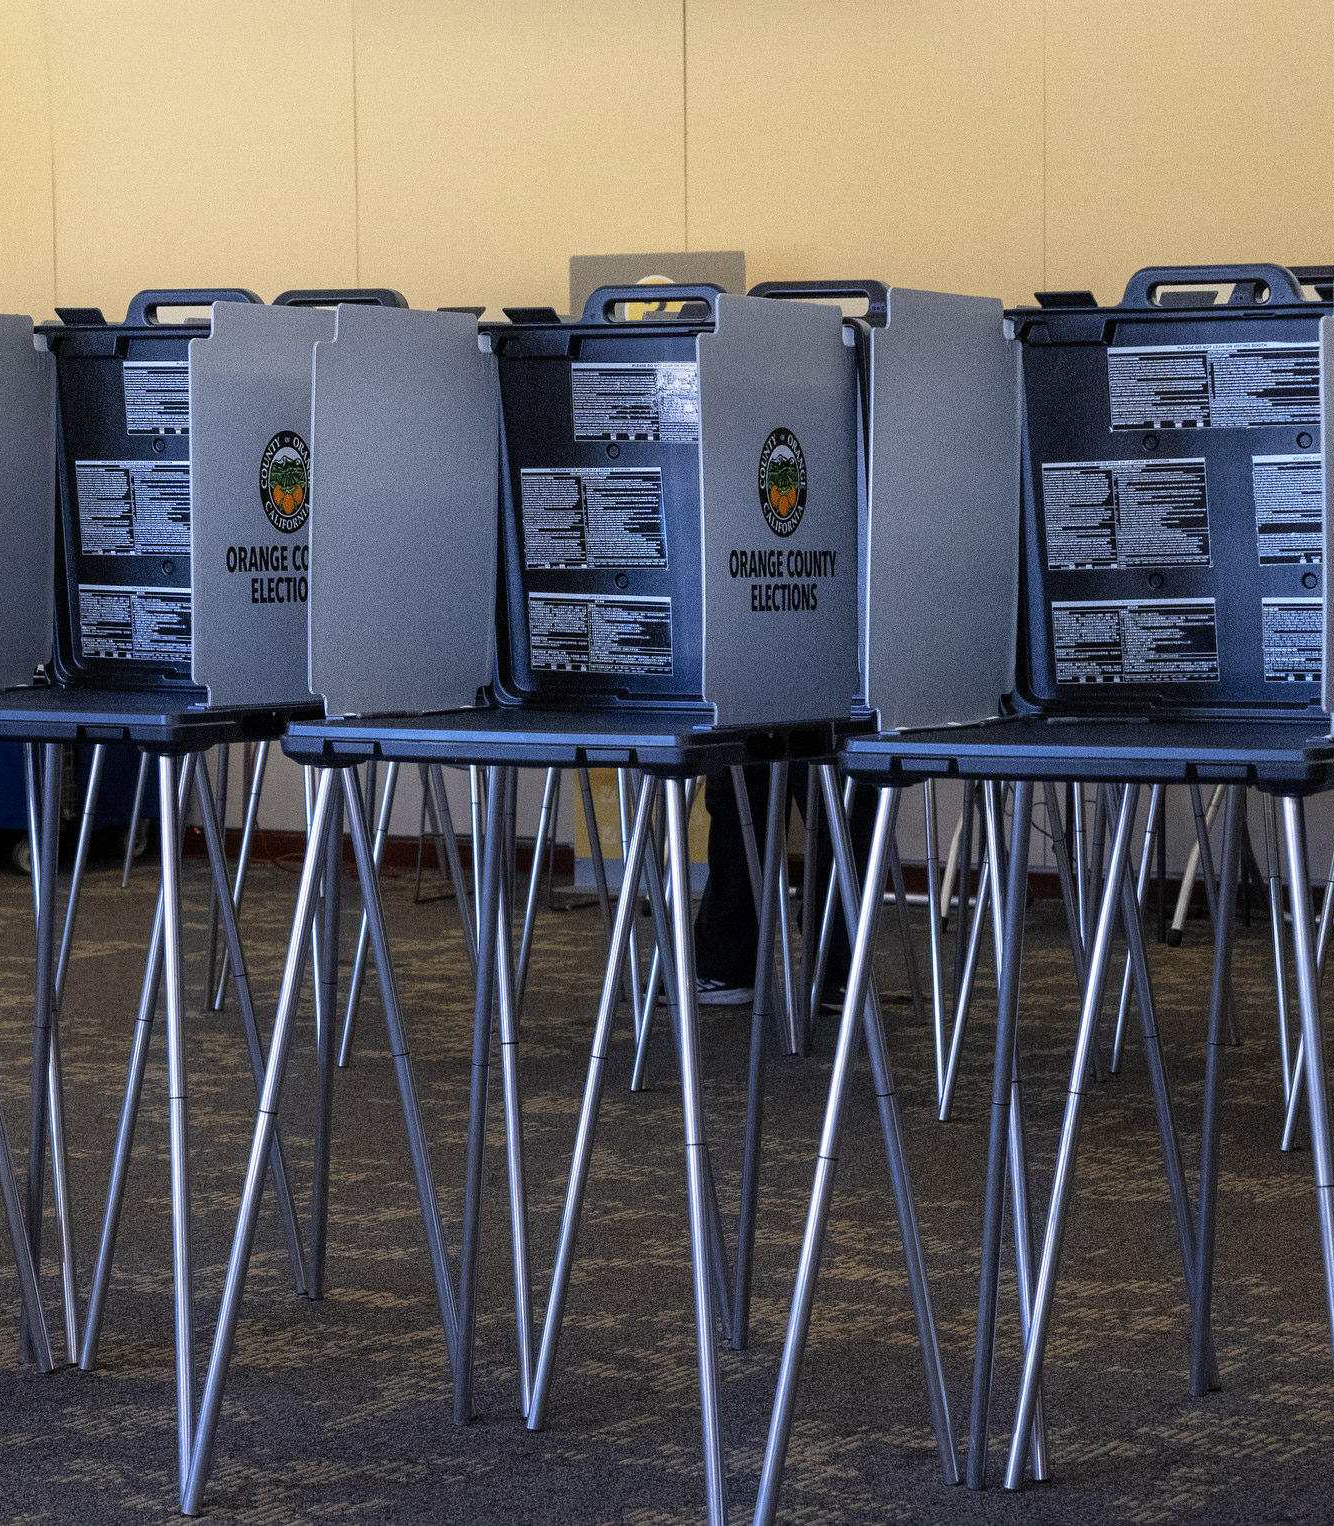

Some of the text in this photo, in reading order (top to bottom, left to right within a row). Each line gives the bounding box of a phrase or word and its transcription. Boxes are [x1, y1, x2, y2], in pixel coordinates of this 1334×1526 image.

[261, 436, 280, 489] COUNTY
[760, 434, 777, 489] COUNTY
[787, 434, 806, 490] ORANGE
[763, 502, 804, 534] CALIFORNIA
[226, 545, 288, 573] ORANGE
[729, 549, 837, 579] ORANGE COUNTY
[251, 576, 308, 604] ELECTIO
[751, 583, 818, 612] ELECTIONS
